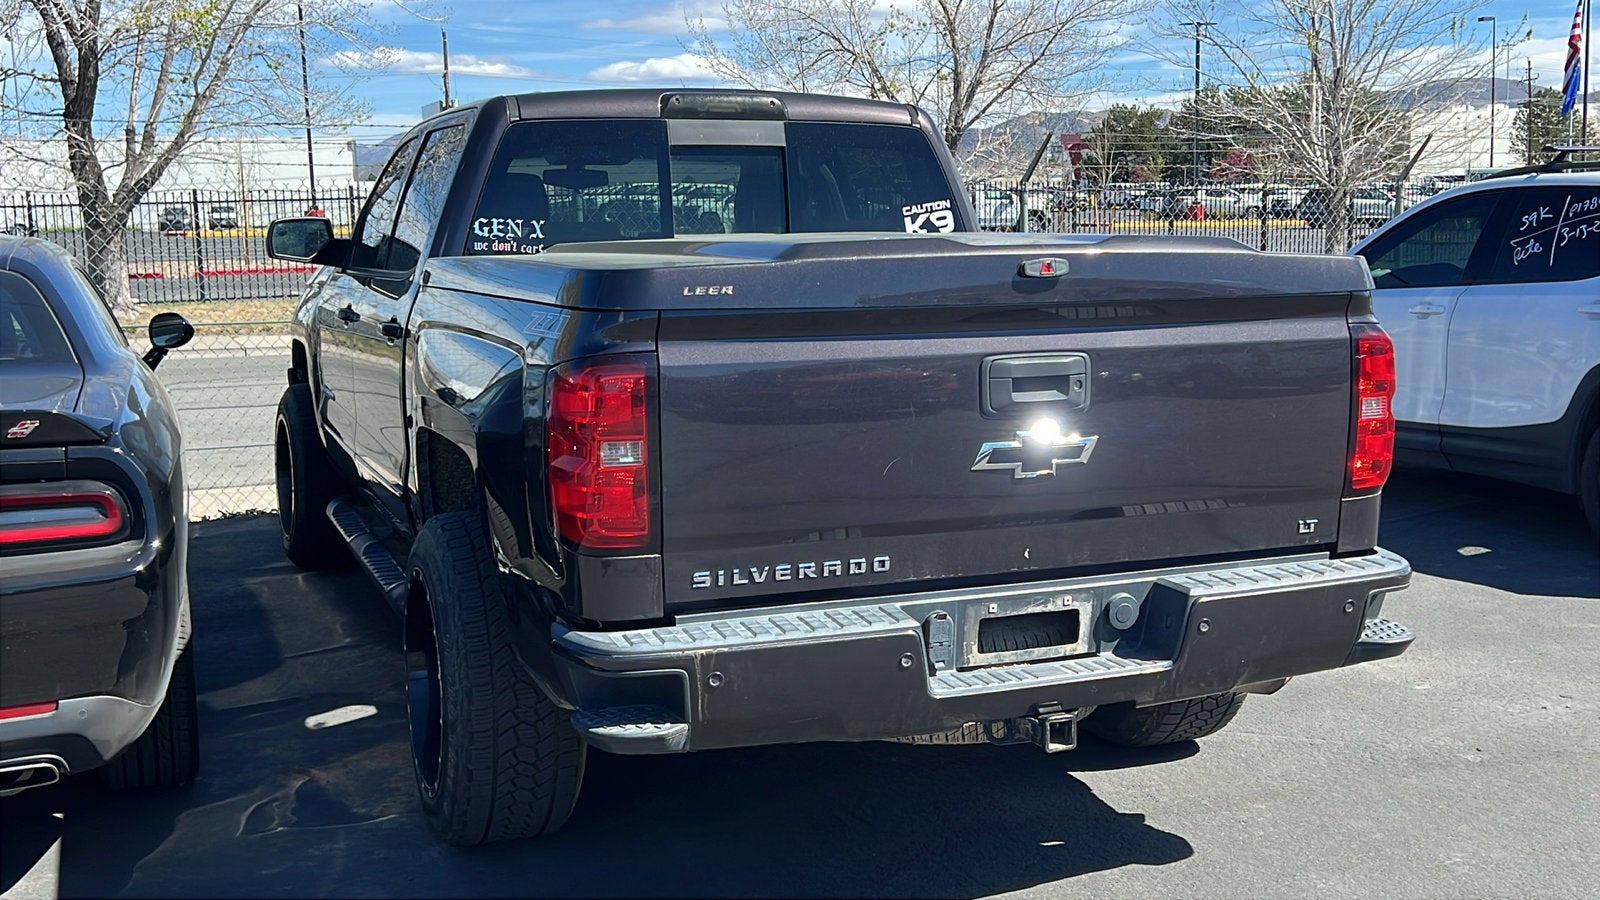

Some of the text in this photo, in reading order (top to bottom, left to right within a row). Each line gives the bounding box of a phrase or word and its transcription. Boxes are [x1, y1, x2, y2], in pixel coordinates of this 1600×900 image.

[902, 200, 951, 216] CAUTION
[473, 217, 545, 240] GEN X
[904, 209, 955, 234] K9
[474, 241, 489, 251] we
[492, 240, 517, 252] don't
[683, 285, 734, 296] LEER
[523, 310, 571, 340] Z71
[1298, 519, 1319, 534] LT
[692, 555, 891, 589] SILVERADO
